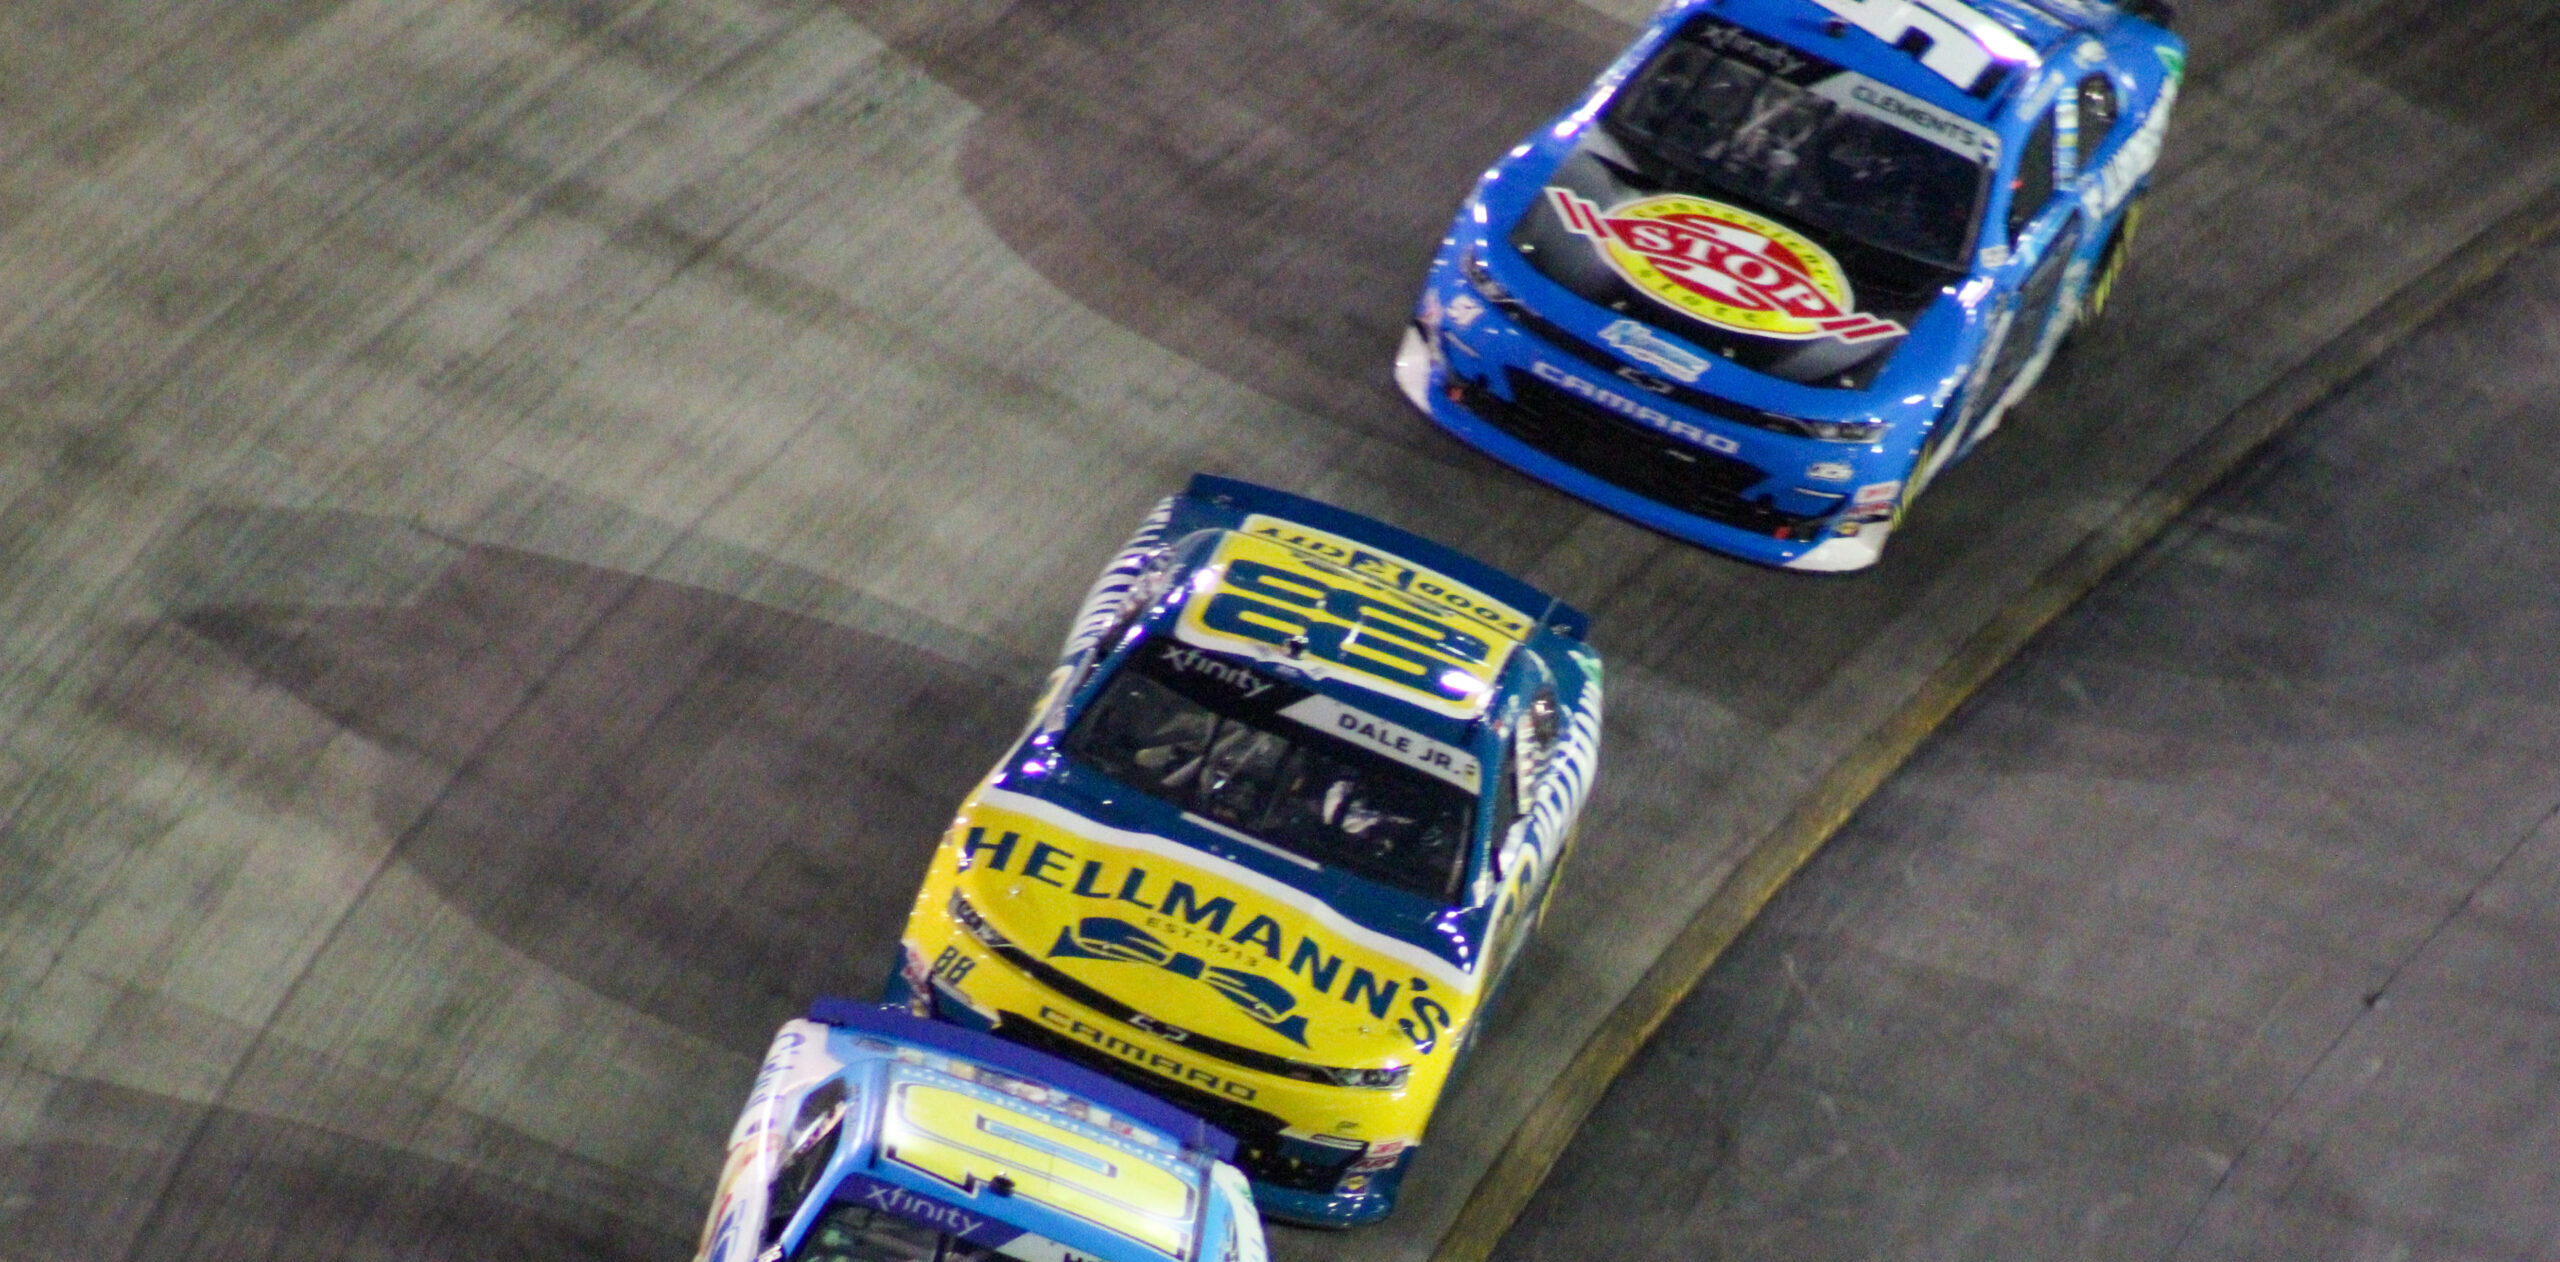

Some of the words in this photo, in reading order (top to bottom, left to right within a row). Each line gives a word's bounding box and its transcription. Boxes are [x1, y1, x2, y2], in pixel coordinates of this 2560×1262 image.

[1852, 84, 1976, 147] CLEMENTS
[1631, 223, 1828, 312] STOP
[1531, 360, 1741, 454] CAMARO
[1256, 526, 1348, 560] CITY
[1202, 558, 1491, 703] 88
[1418, 578, 1523, 633] FOOD
[1160, 644, 1275, 698] xfinity
[1338, 703, 1411, 754] DALE
[1418, 747, 1460, 775] JR.
[931, 945, 977, 986] 88
[957, 826, 1452, 1055] HELLMANN'S
[1039, 1005, 1258, 1102] CAMARO
[865, 1183, 984, 1238] xfinity
